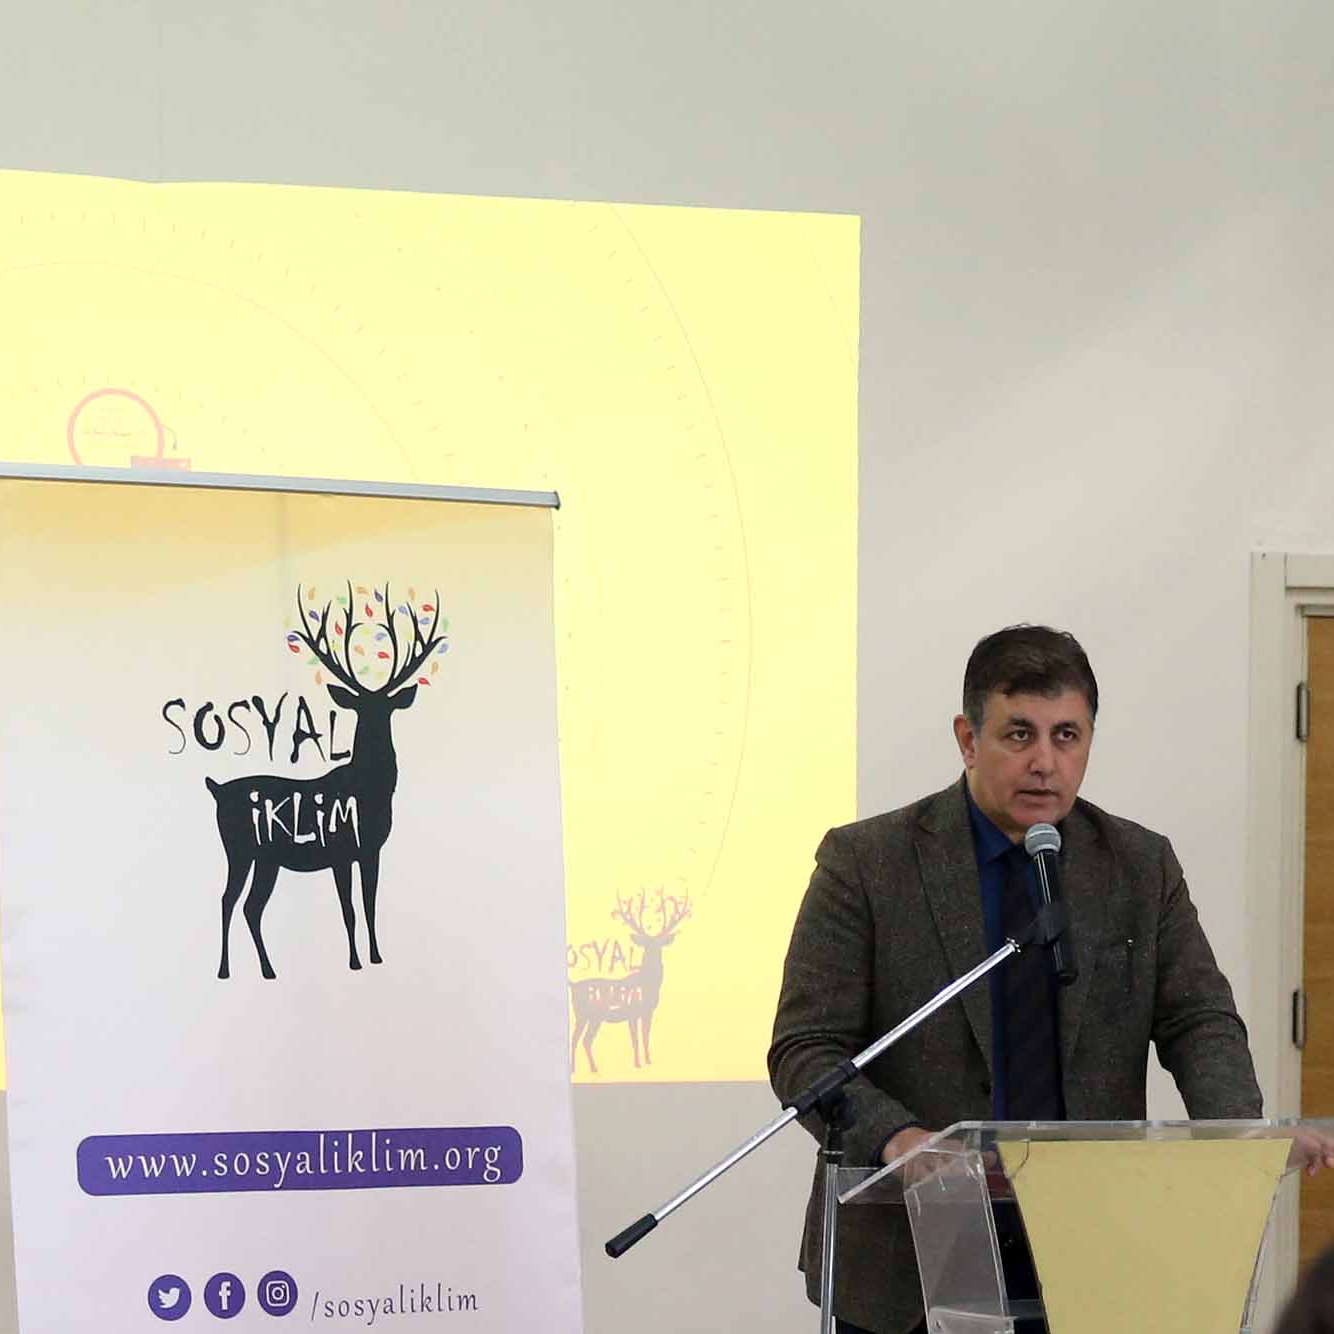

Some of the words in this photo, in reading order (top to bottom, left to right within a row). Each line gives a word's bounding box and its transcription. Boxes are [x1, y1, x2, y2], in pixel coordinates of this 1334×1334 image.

[162, 692, 351, 763] SOSYAL
[567, 938, 641, 973] OSYAL
[104, 1130, 502, 1188] www.sosyaliklim.org
[310, 1284, 479, 1326] /sosyaliklim
